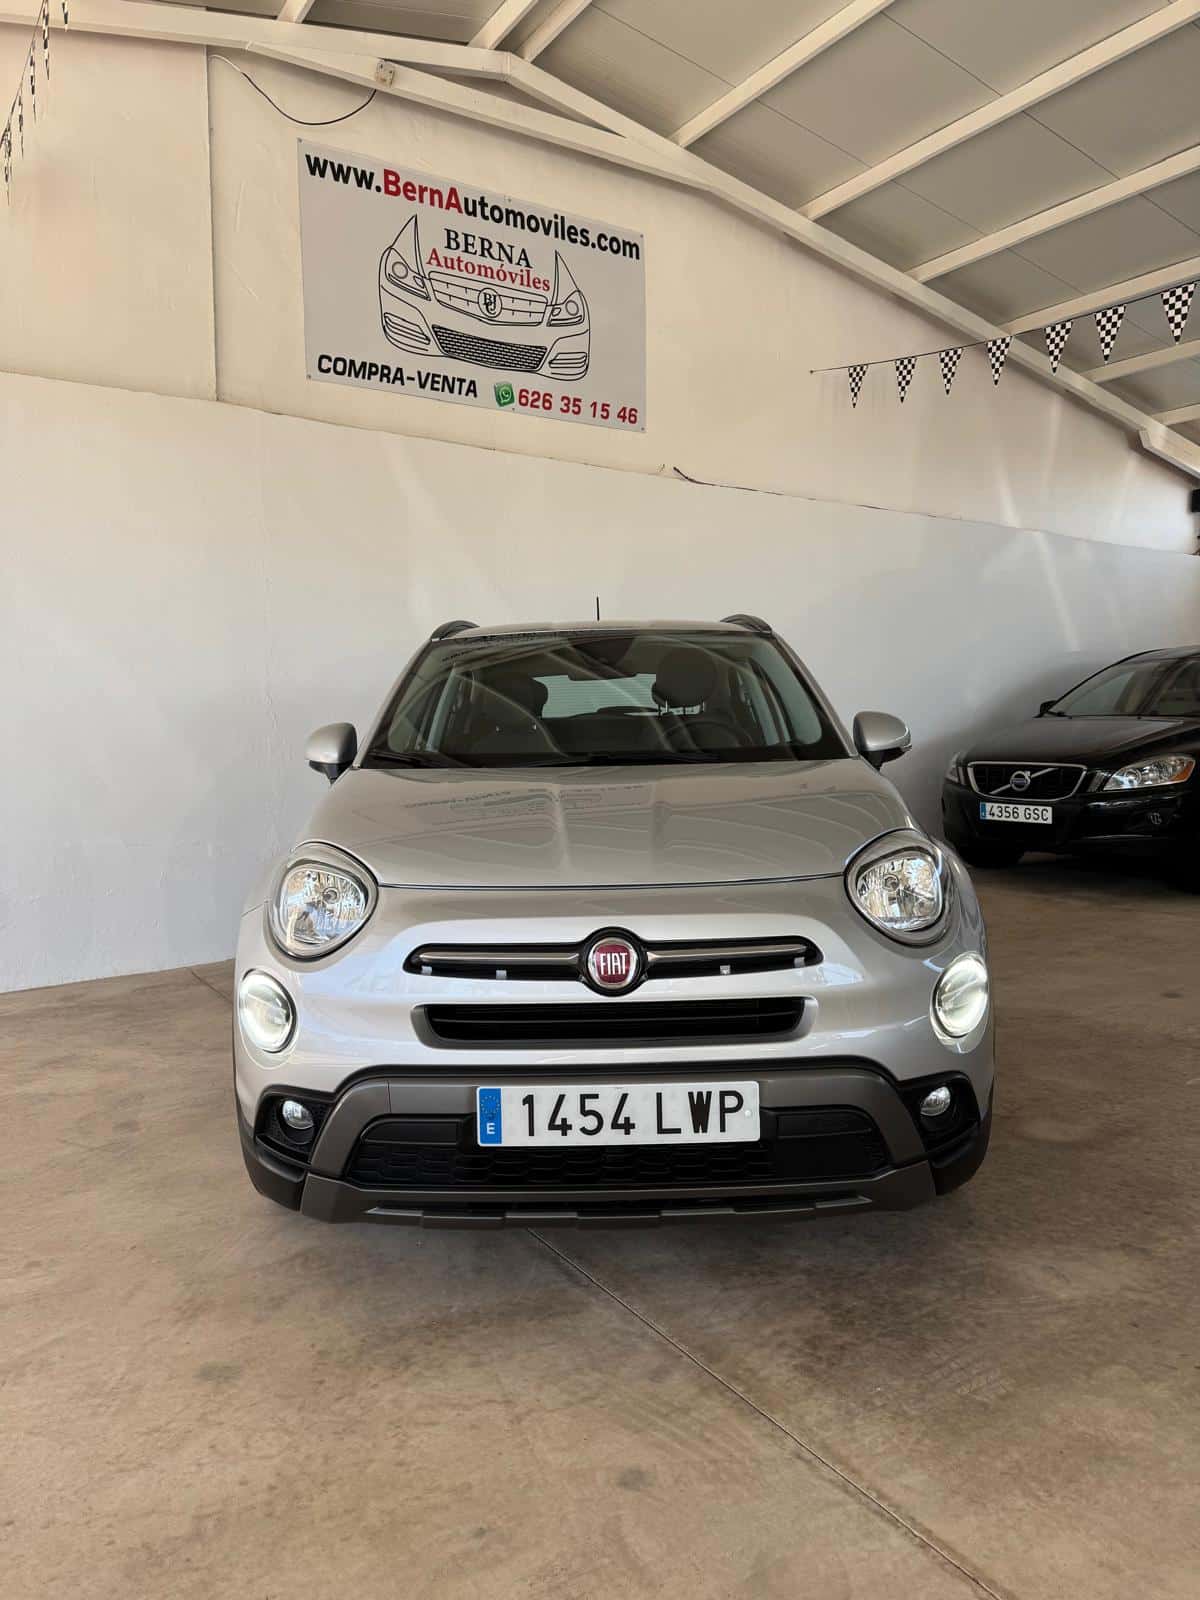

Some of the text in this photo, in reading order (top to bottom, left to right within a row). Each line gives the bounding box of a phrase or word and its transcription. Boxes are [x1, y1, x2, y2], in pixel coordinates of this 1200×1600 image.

[305, 154, 640, 260] www.BernAutomoviles.com
[444, 228, 533, 269] BERNA
[426, 248, 550, 292] Automóviles
[317, 354, 478, 398] COMPRA-VENTA
[518, 389, 638, 424] 626 35 15 46
[989, 804, 1020, 819] 4356
[1024, 807, 1049, 821] GSC
[600, 952, 628, 976] FIAT
[486, 1122, 495, 1135] E
[522, 1090, 744, 1137] 1454 LWP
